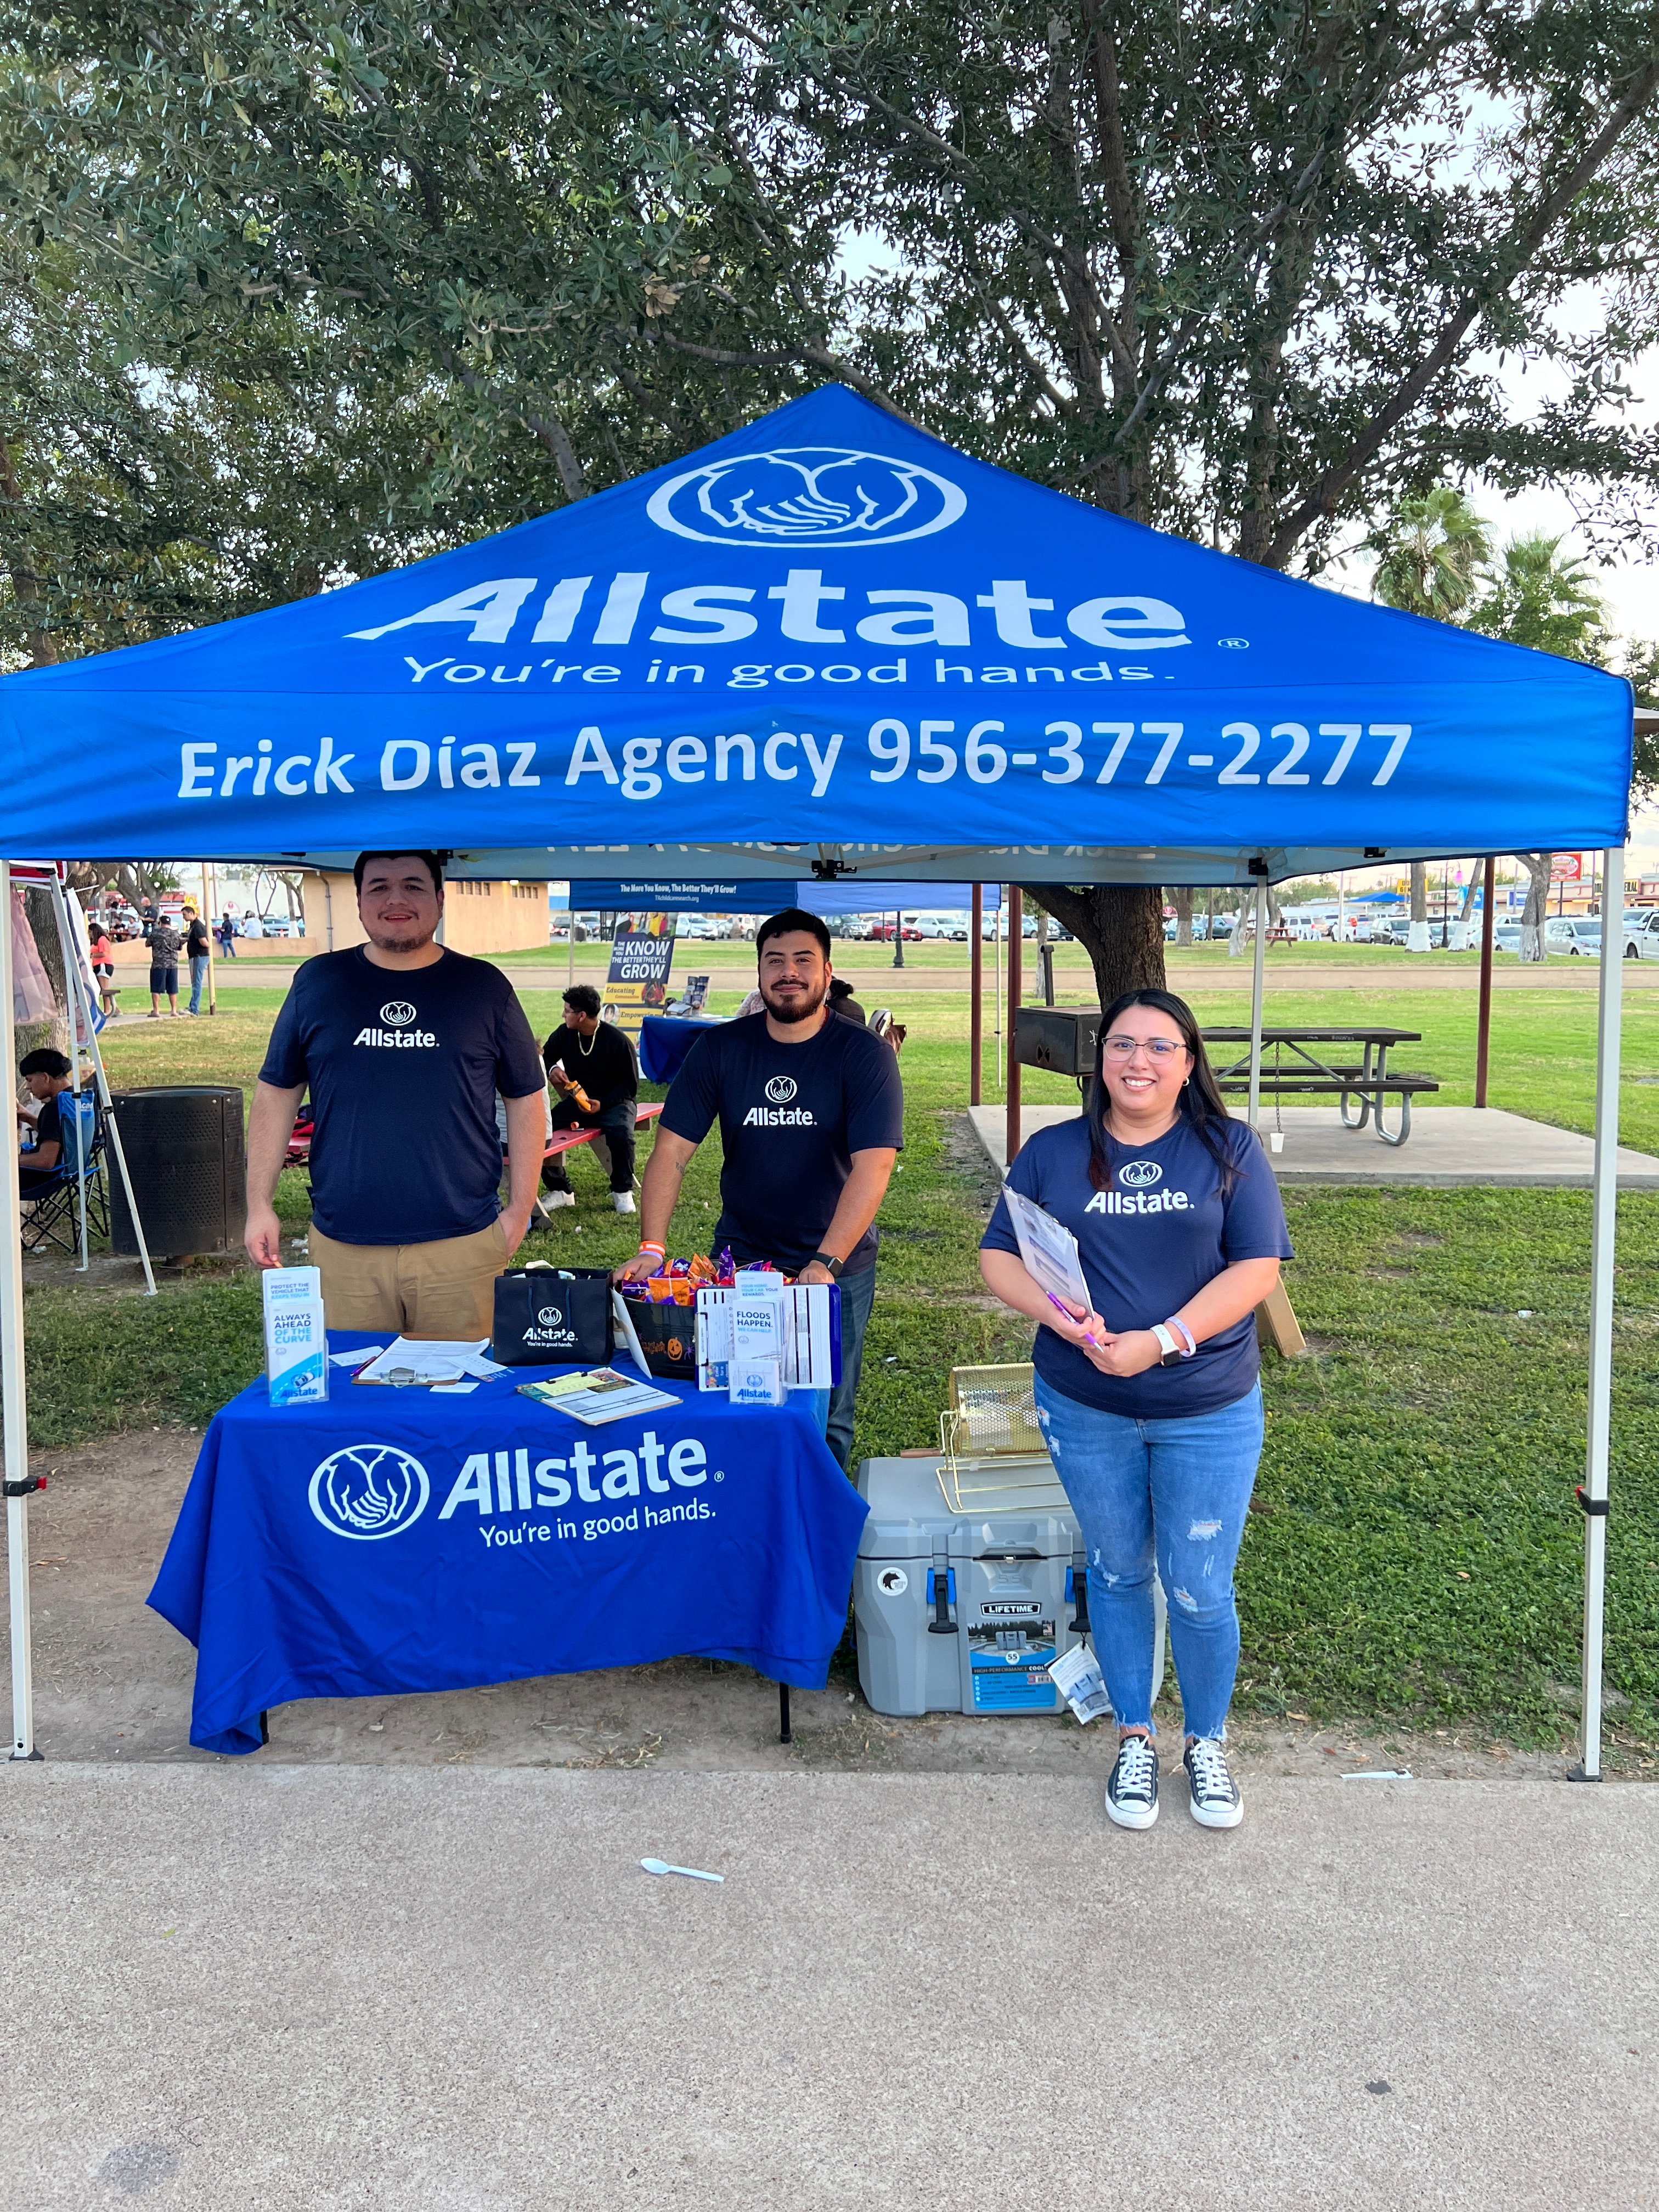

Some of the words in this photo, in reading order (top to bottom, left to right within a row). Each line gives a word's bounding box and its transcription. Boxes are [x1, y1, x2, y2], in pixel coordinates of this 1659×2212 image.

[343, 569, 1192, 650] Allstate
[404, 657, 620, 684] You're
[647, 659, 704, 682] in
[727, 658, 906, 688] good
[936, 659, 1174, 683] hands.
[178, 737, 354, 797] Erick
[565, 727, 843, 799] Agency
[868, 719, 1411, 785] 956-377-2277
[620, 884, 630, 892] The
[631, 884, 644, 892] More
[644, 884, 654, 892] You
[654, 884, 671, 893] Know,
[672, 884, 681, 892] The
[682, 884, 700, 893] Better
[719, 885, 737, 894] Grow!
[625, 940, 670, 956] KNOW
[620, 963, 666, 979] GROW
[737, 1311, 770, 1319] FLOODS
[275, 1320, 311, 1329] AHEAD
[275, 1335, 312, 1344] CURVE
[737, 1389, 771, 1398] Allstate
[438, 1431, 707, 1519] Allstate
[479, 1522, 550, 1547] You're
[557, 1518, 576, 1538] in
[584, 1508, 638, 1540] good
[645, 1498, 715, 1527] hands.
